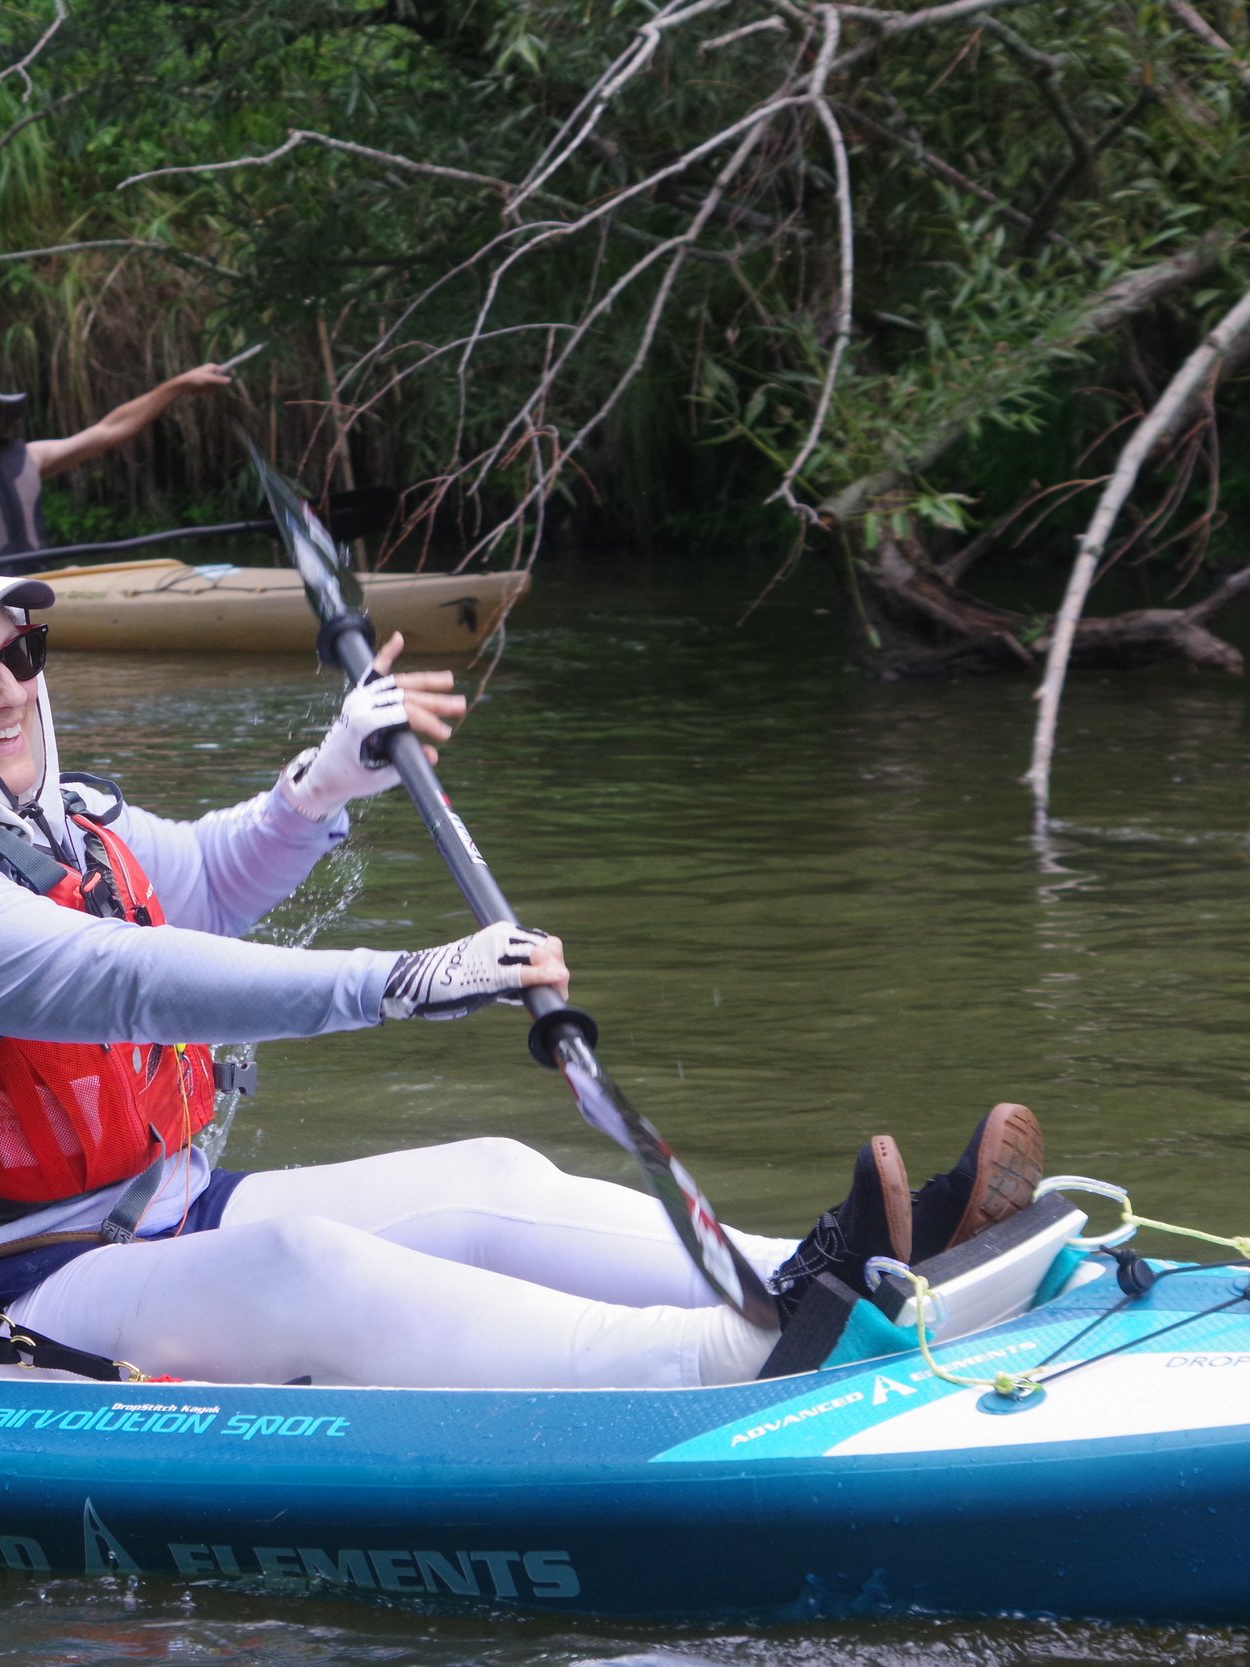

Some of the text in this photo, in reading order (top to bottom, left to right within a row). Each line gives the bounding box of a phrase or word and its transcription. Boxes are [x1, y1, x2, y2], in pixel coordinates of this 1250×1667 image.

[180, 1404, 221, 1414] Kayak
[731, 1391, 865, 1447] ADVANCED
[167, 1543, 581, 1598] ELEMENTS
